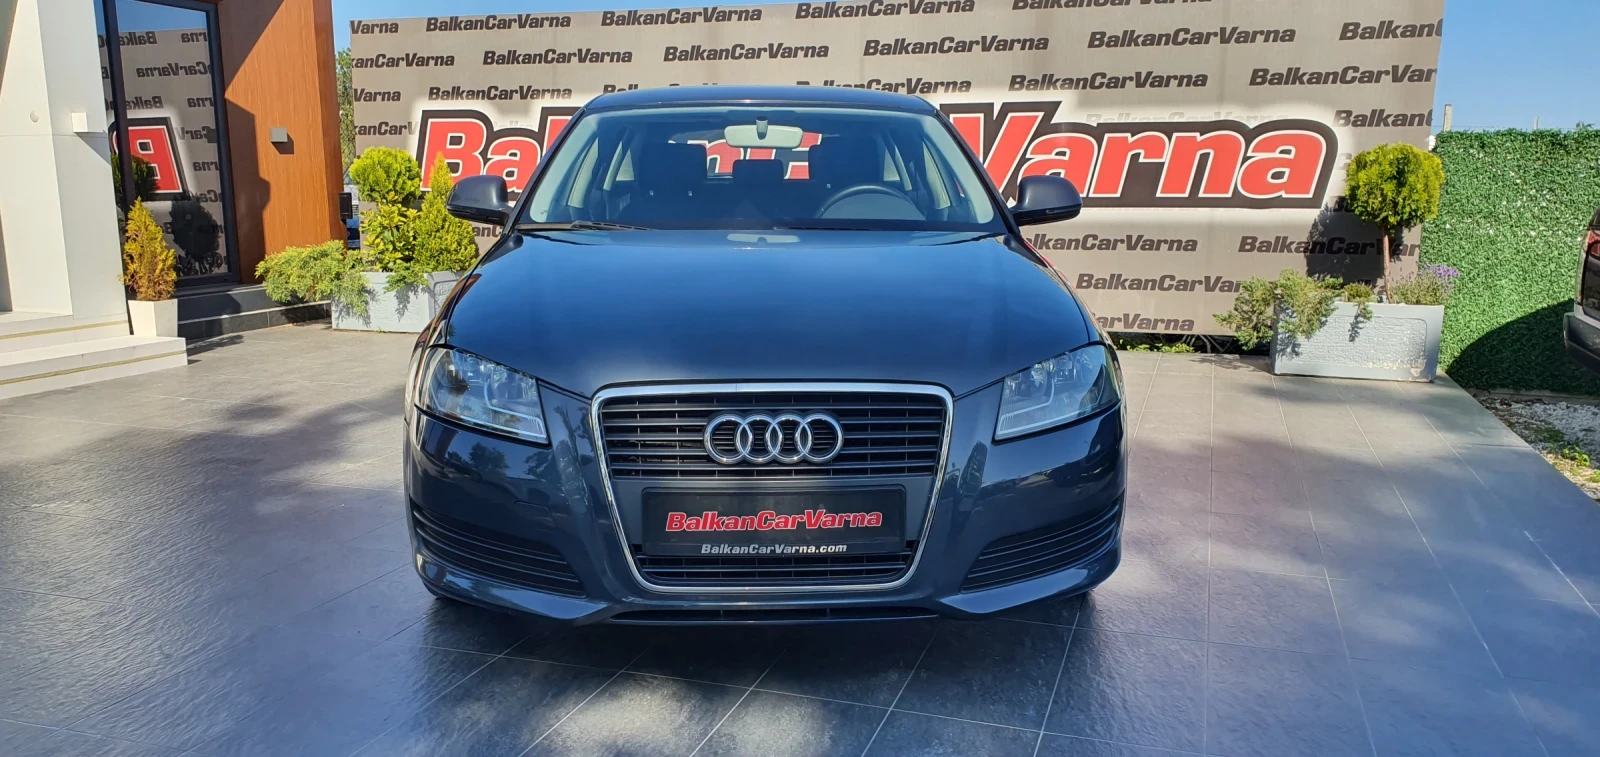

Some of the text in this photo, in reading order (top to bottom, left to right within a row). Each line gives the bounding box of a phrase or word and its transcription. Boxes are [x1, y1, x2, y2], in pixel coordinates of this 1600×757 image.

[601, 7, 762, 27] BalkanCarVarna
[795, 0, 975, 19] BalkanCarVarna
[426, 14, 571, 32] BalkanCarVarna
[863, 35, 1049, 56] BalkanCarVarna
[1087, 27, 1296, 49] BalkanCarVarna
[482, 48, 633, 66] BalkanCarVarna
[664, 43, 829, 62] BalkanCarVarna
[1008, 71, 1208, 92] BalkanCarVarna
[428, 85, 572, 101] BalkanCarVarna
[665, 508, 883, 532] BalkanCarVarna
[701, 543, 847, 555] BalkanCarVarna.com
